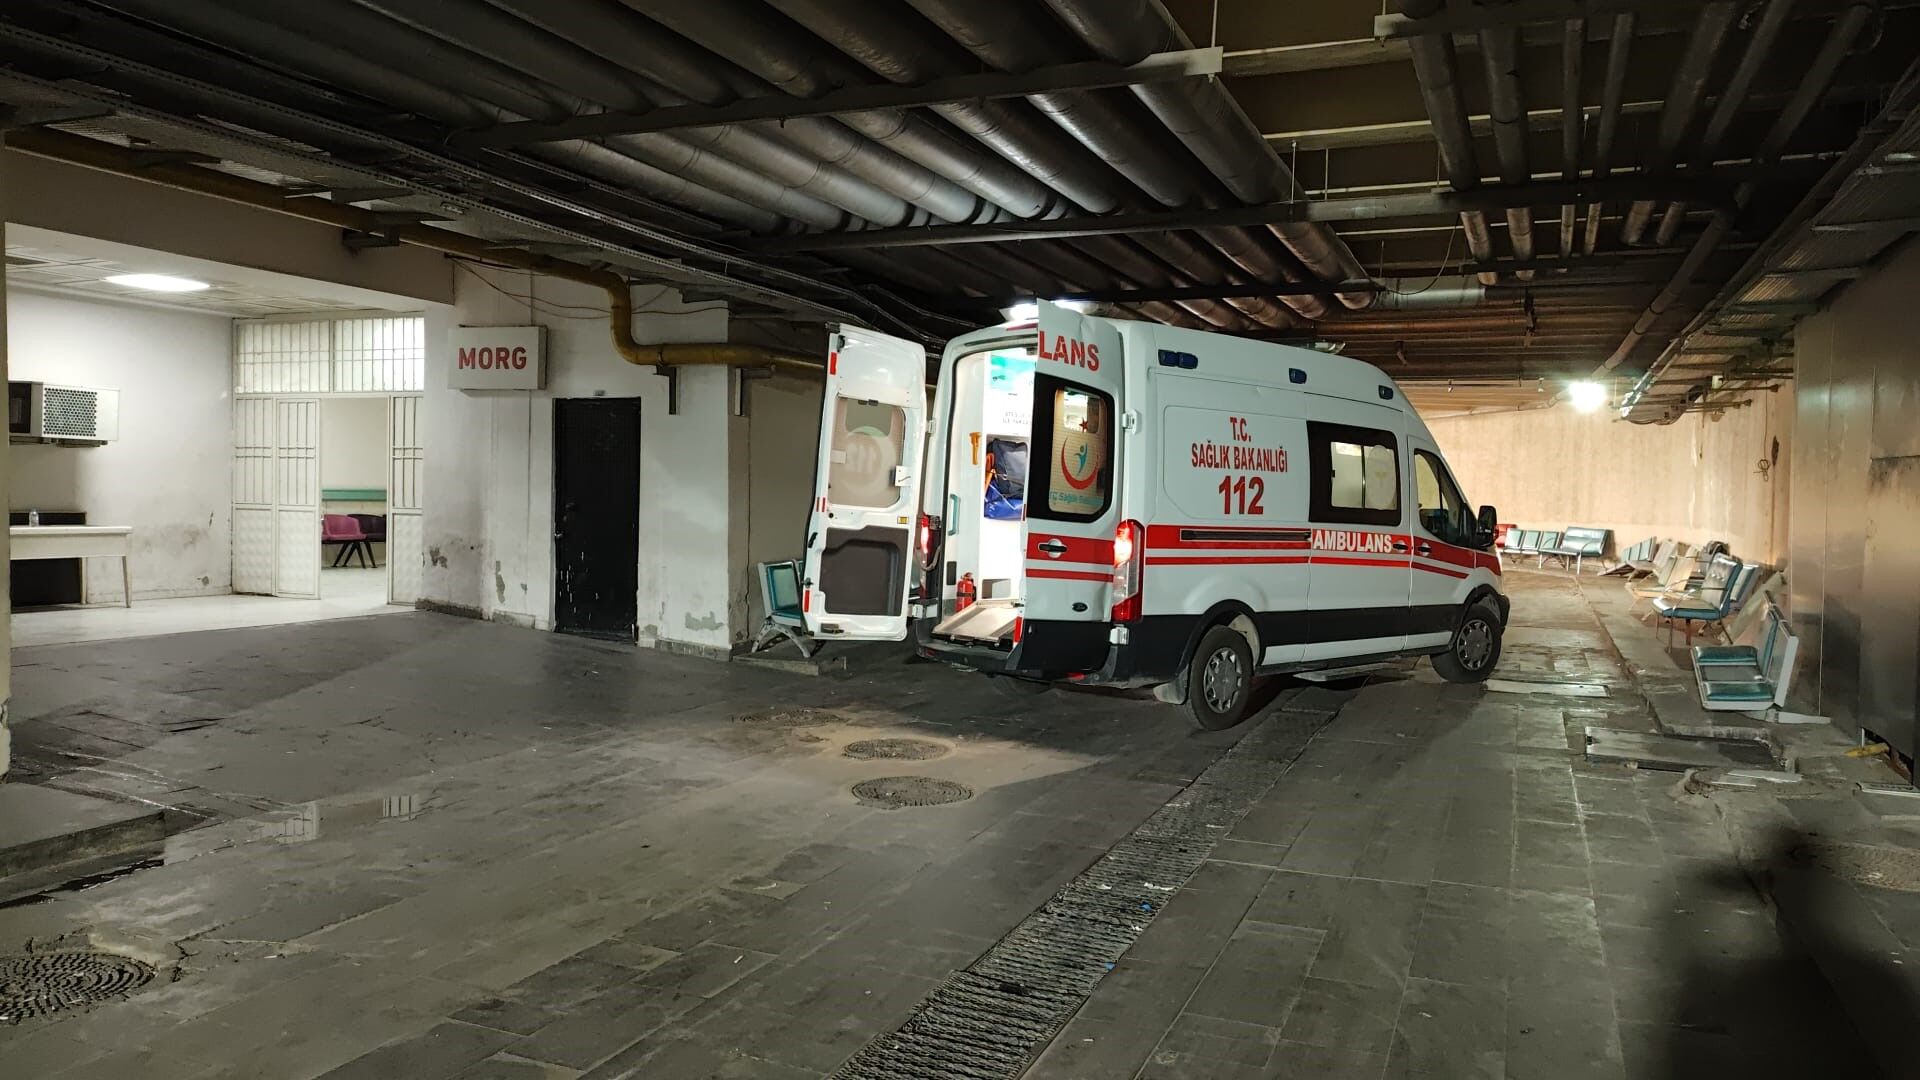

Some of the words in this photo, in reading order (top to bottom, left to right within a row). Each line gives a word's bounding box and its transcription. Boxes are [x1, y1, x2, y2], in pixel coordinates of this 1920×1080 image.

[458, 346, 527, 370] MORG
[1039, 330, 1099, 372] LANS
[1229, 416, 1252, 443] T.C.
[1191, 439, 1231, 470] SAĞLIK
[1233, 445, 1288, 473] BAKANLIĞI
[1218, 475, 1265, 515] 112
[1313, 530, 1393, 553] AMBULANS
